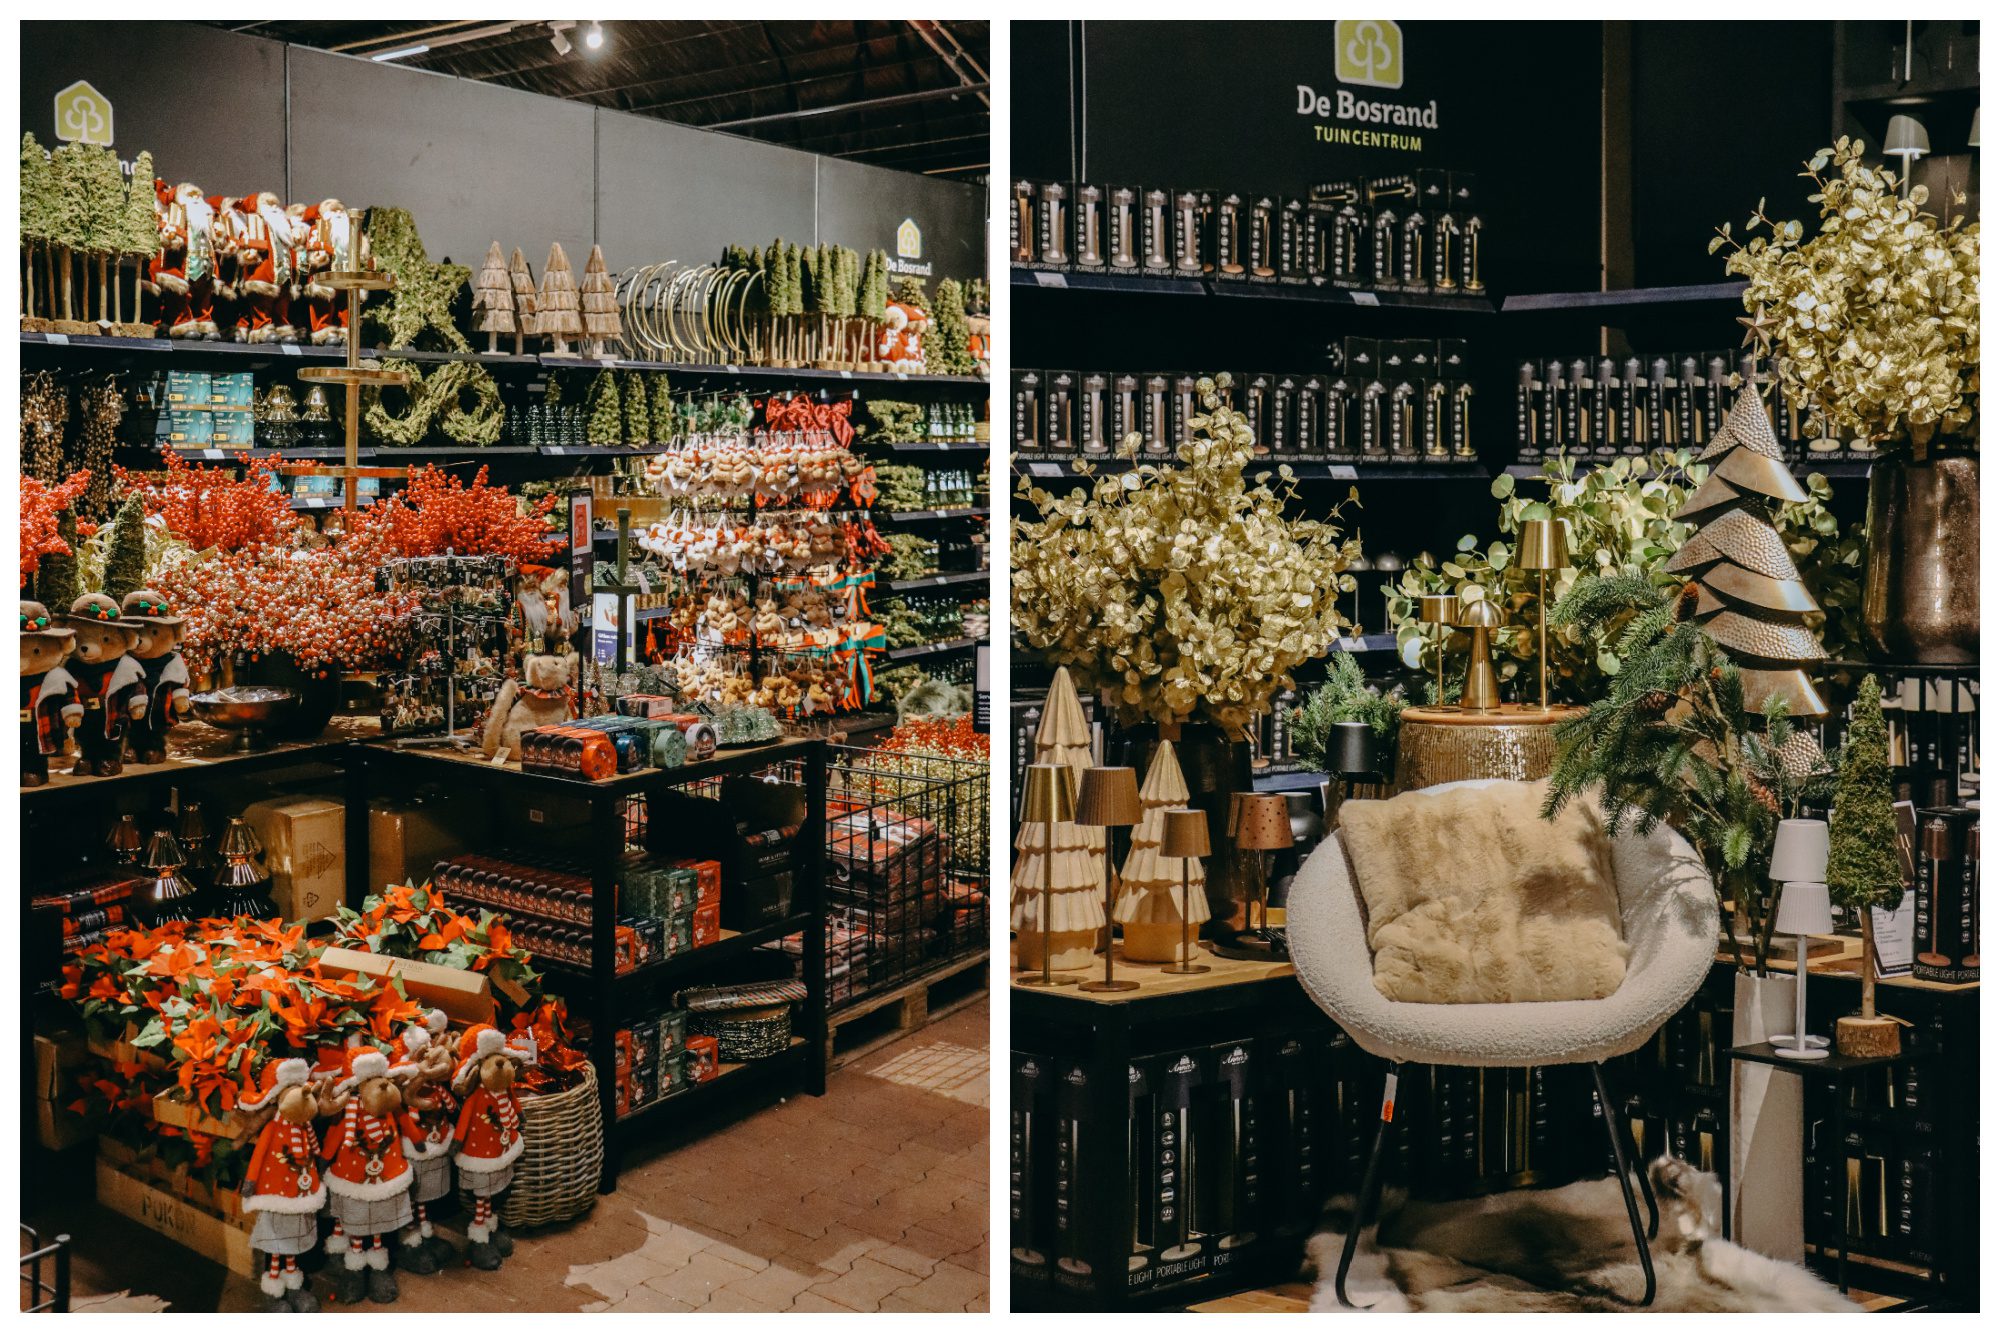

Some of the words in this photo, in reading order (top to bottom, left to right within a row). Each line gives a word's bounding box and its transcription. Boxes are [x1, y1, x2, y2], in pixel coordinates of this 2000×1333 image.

[1297, 84, 1331, 118] De
[1336, 89, 1439, 130] Bosrand
[1313, 125, 1423, 152] TUINCENTRUM
[886, 257, 897, 271] De
[898, 258, 932, 276] Bosrand
[1807, 451, 1829, 460] PORTABLE
[1830, 451, 1844, 460] LIGHT
[1913, 964, 1939, 978] PORTABLE
[1939, 968, 1956, 979] LIGHT
[1155, 1262, 1188, 1279] PORTABLE
[1187, 1255, 1207, 1271] LIGHT
[1133, 1269, 1153, 1285] LIGHT
